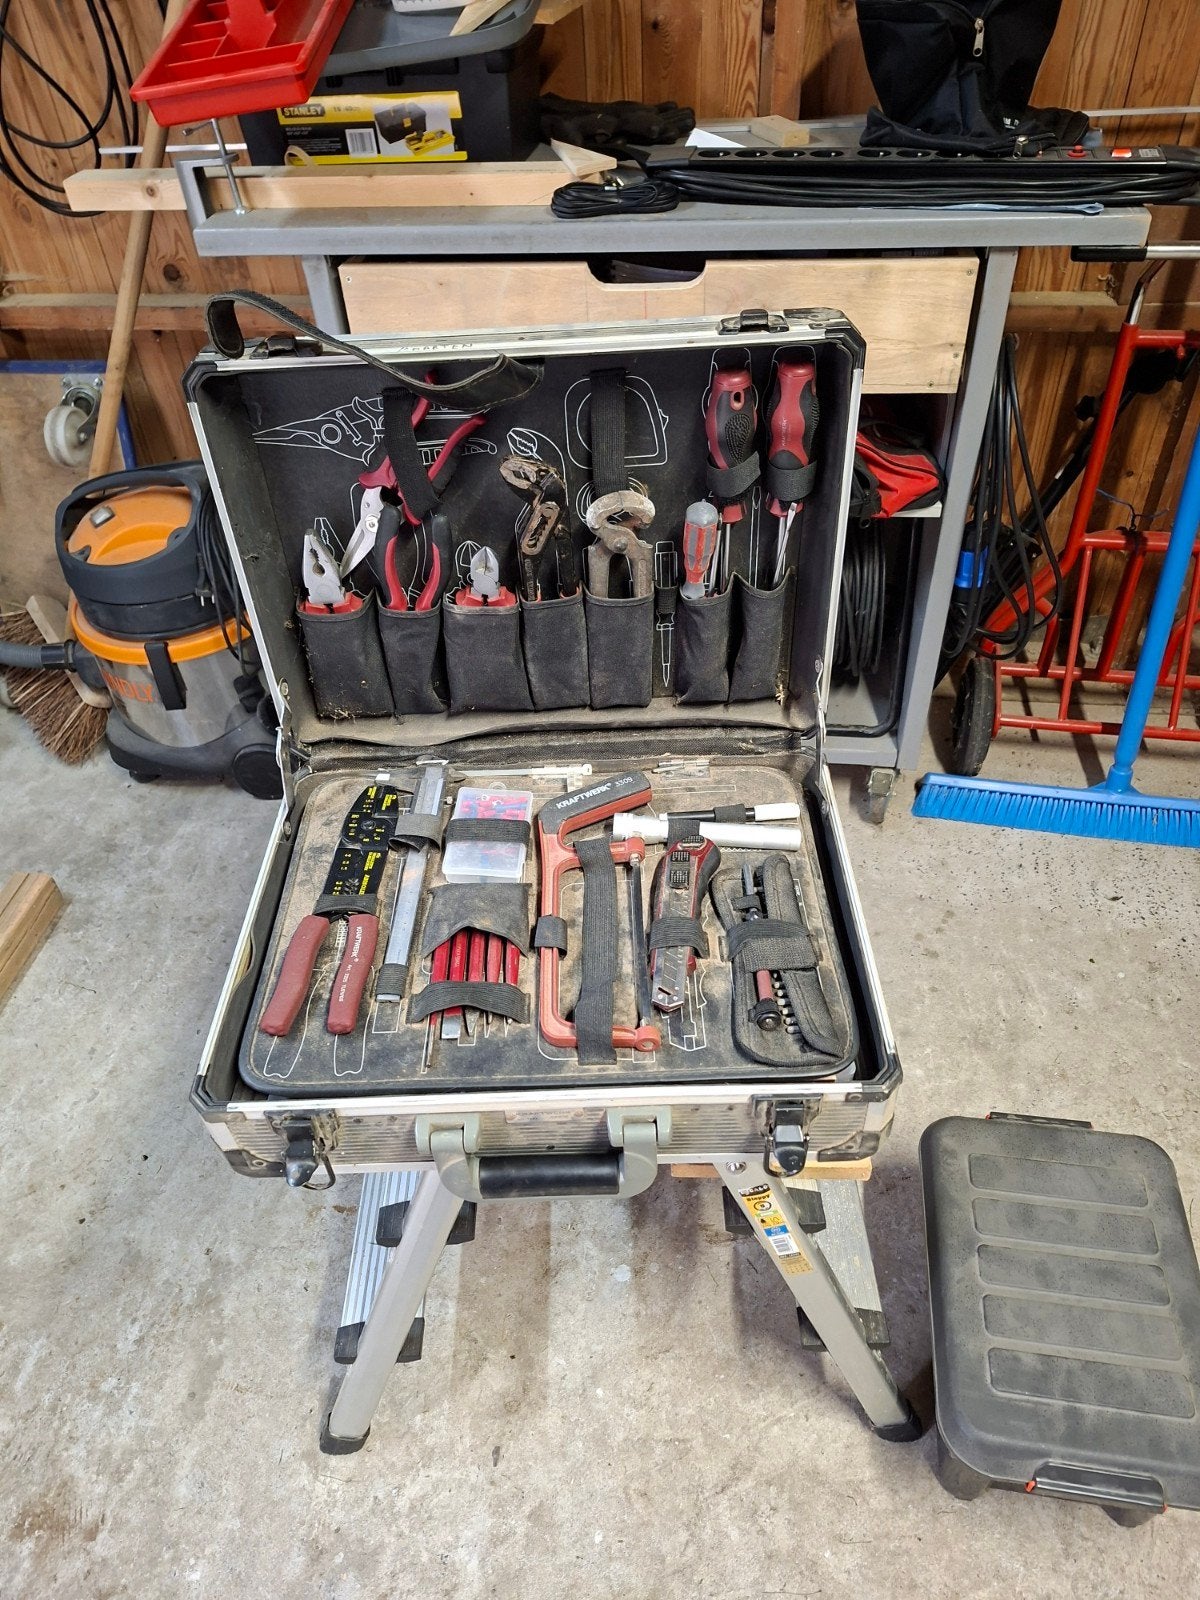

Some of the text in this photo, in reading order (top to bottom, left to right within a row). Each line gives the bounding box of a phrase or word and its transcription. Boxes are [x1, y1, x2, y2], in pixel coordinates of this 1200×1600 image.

[283, 105, 322, 116] STANLEY
[556, 776, 634, 809] KRAFTWERK 3309
[351, 926, 363, 958] KRAFTWERK
